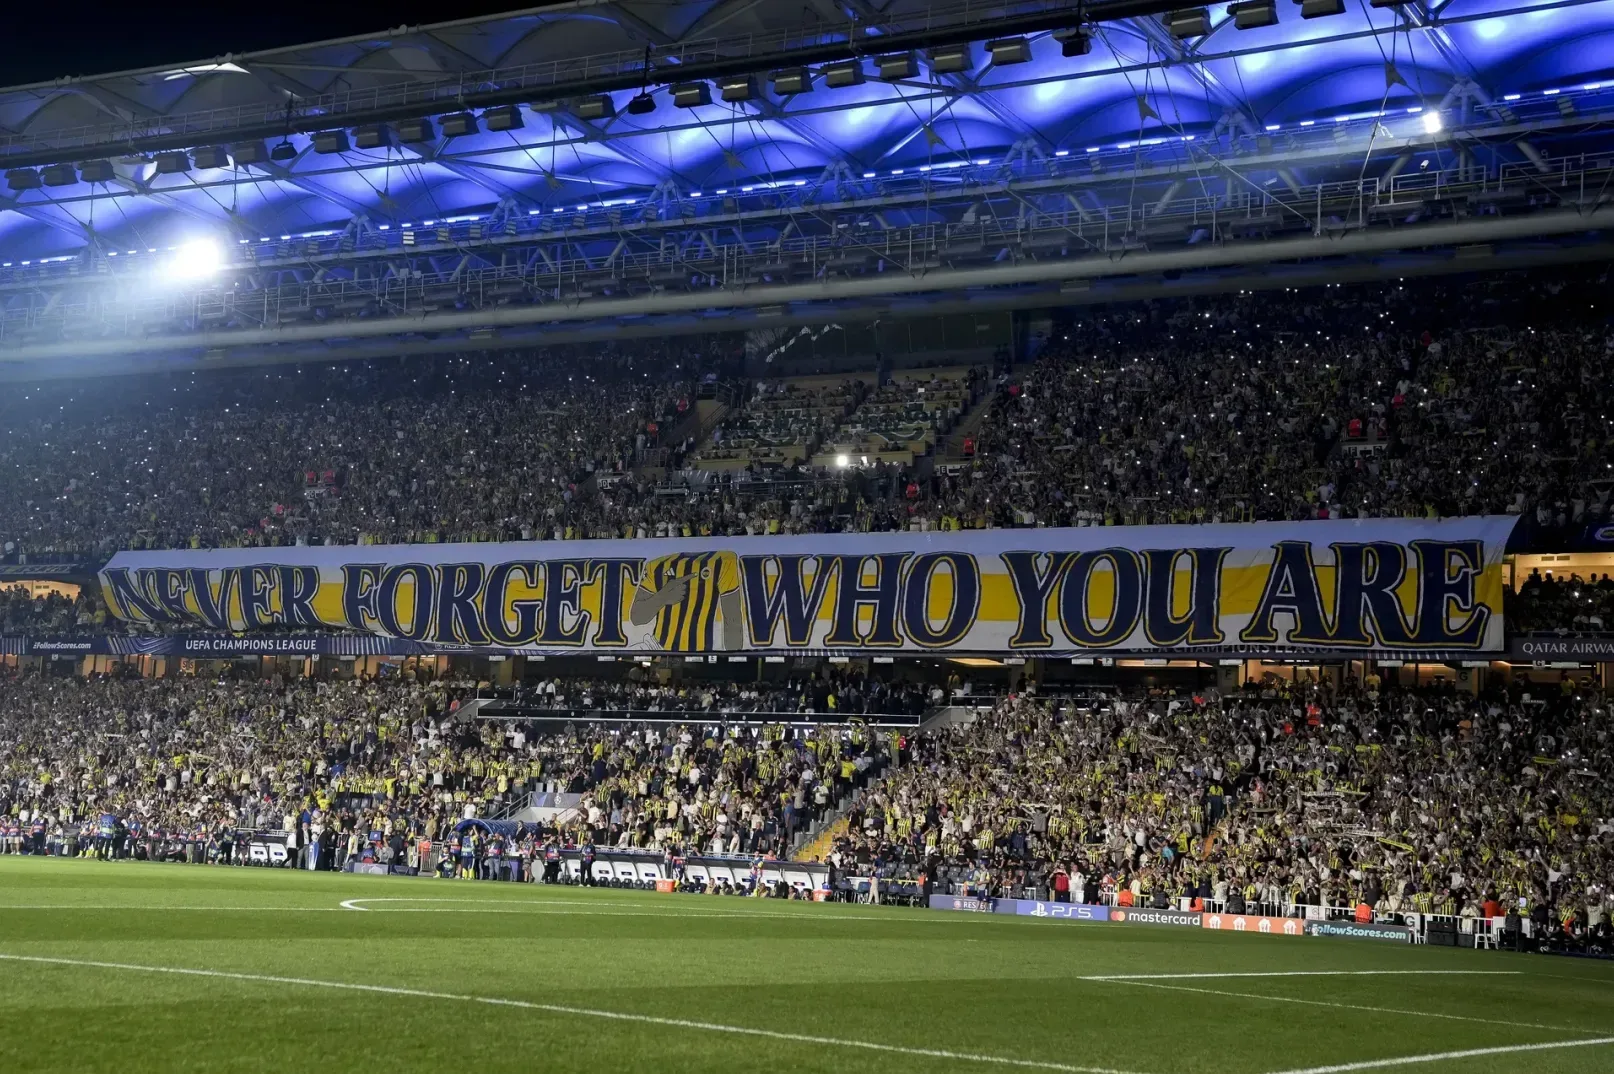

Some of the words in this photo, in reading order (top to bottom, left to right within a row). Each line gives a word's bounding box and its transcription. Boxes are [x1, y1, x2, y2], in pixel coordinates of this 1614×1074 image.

[104, 562, 328, 631] NEVER
[340, 561, 646, 647] FORGET
[739, 551, 981, 648] WHO
[999, 546, 1235, 648] YOU
[1239, 539, 1491, 649] ARE
[185, 639, 211, 650] UEFA
[213, 639, 274, 650] CHAMPIONS
[276, 639, 317, 650] LEAGUE
[1522, 642, 1568, 655] QATAR
[1459, 671, 1468, 681] G
[1052, 905, 1092, 919] PS5
[1128, 912, 1201, 926] mastercard
[1405, 915, 1416, 928] G
